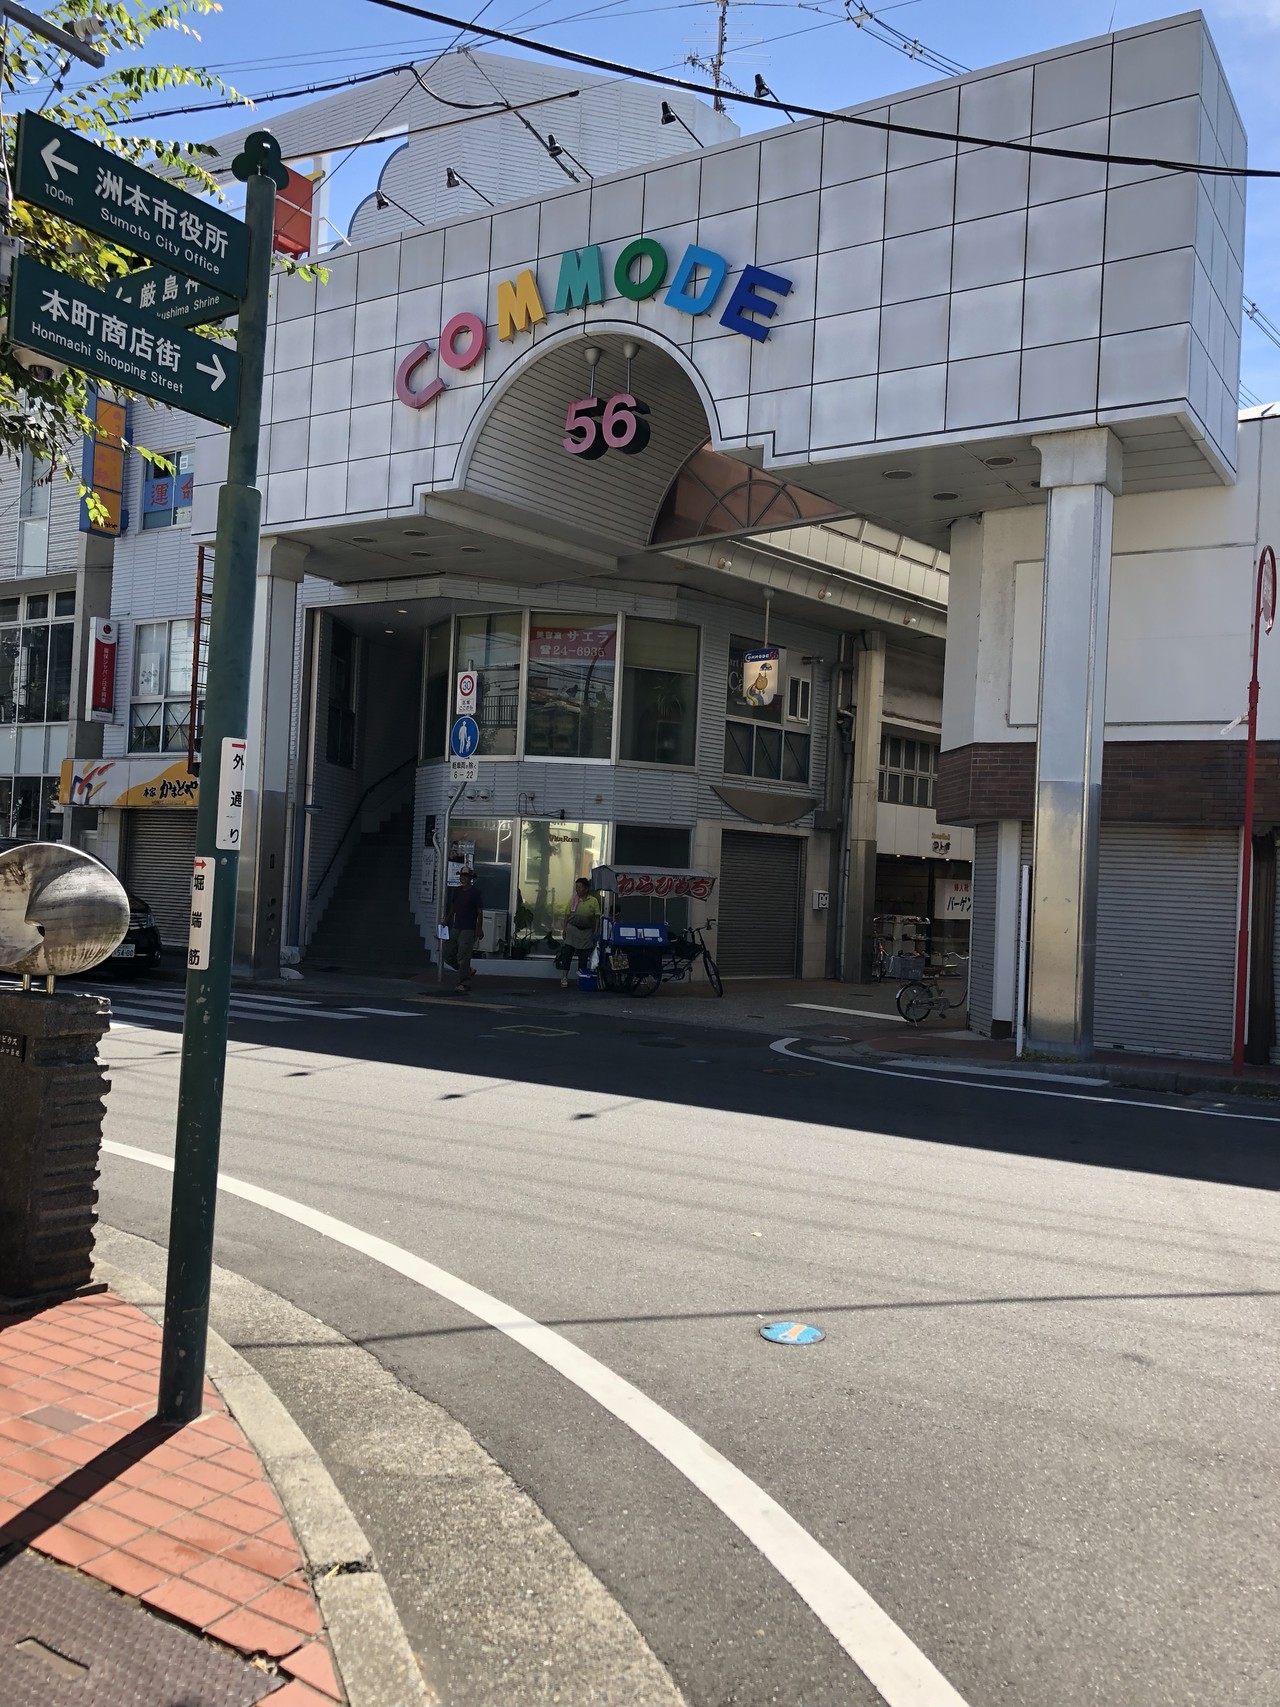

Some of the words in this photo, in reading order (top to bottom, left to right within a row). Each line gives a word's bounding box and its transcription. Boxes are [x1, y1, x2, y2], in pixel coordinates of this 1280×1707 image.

[45, 183, 74, 206] 100m
[95, 167, 229, 259] 洲本市役所
[101, 208, 151, 241] Sumoto
[156, 235, 180, 256] City
[185, 249, 220, 275] Office
[193, 295, 220, 311] Shrine
[396, 238, 794, 410] COMMODE
[40, 289, 181, 373] 本町商店街
[32, 322, 91, 357] Honmachi
[96, 348, 147, 380] Shopping
[151, 372, 184, 394] Street
[562, 393, 646, 458] 56
[567, 631, 609, 643] サエラ
[462, 681, 471, 691] 30
[143, 786, 157, 798] 本家
[230, 753, 245, 843] 外通り
[617, 875, 710, 897] わらびもち
[947, 897, 972, 912] バーゲン
[188, 874, 205, 966] 堀端筋
[0, 1035, 18, 1046] ビウス
